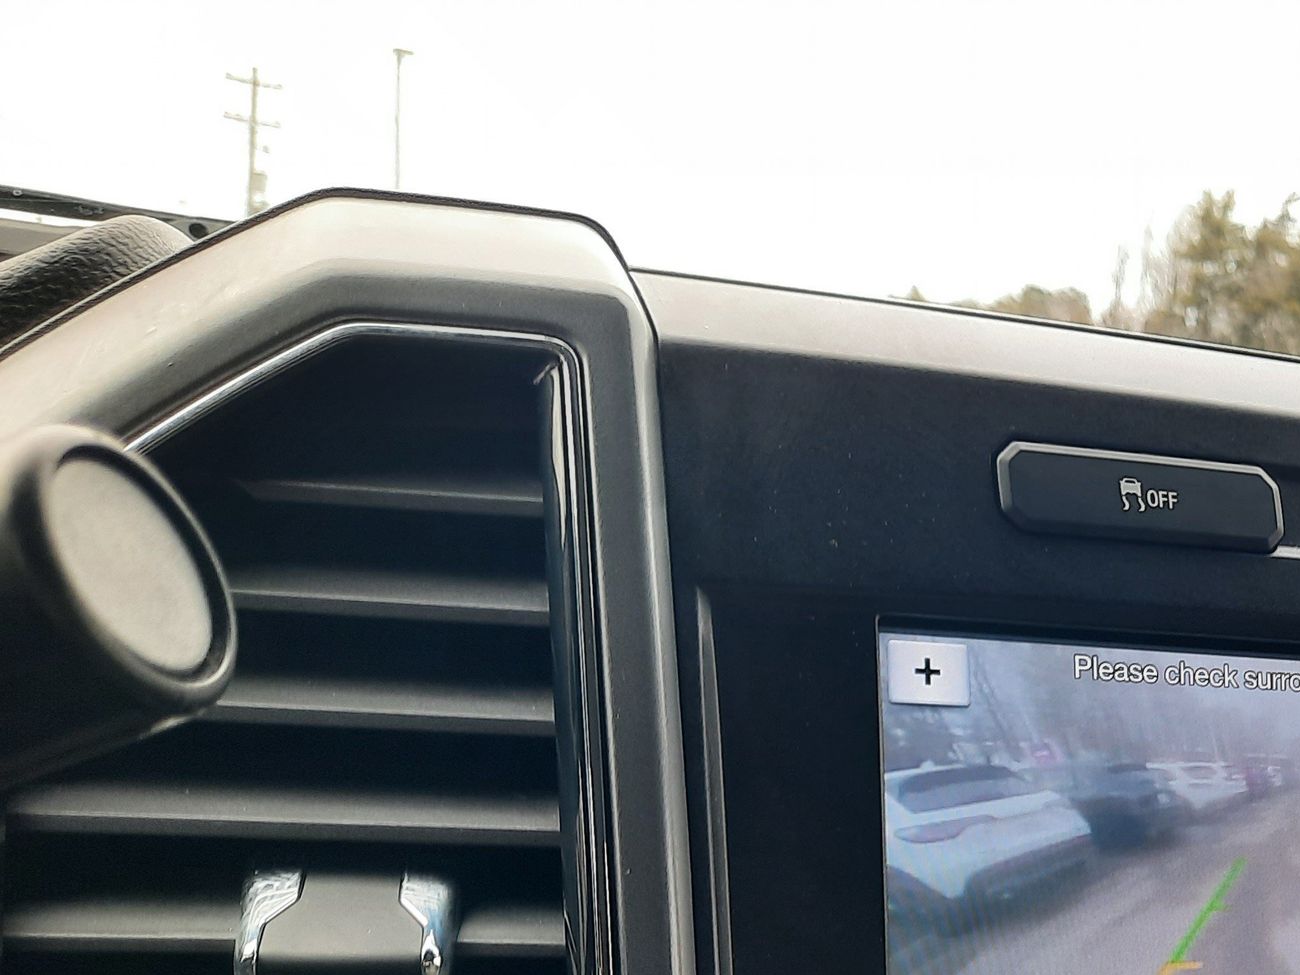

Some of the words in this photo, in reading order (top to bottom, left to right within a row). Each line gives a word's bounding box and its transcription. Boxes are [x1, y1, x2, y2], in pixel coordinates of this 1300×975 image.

[1146, 488, 1179, 511] OFF
[1073, 653, 1158, 684] Please
[1164, 660, 1239, 688] check
